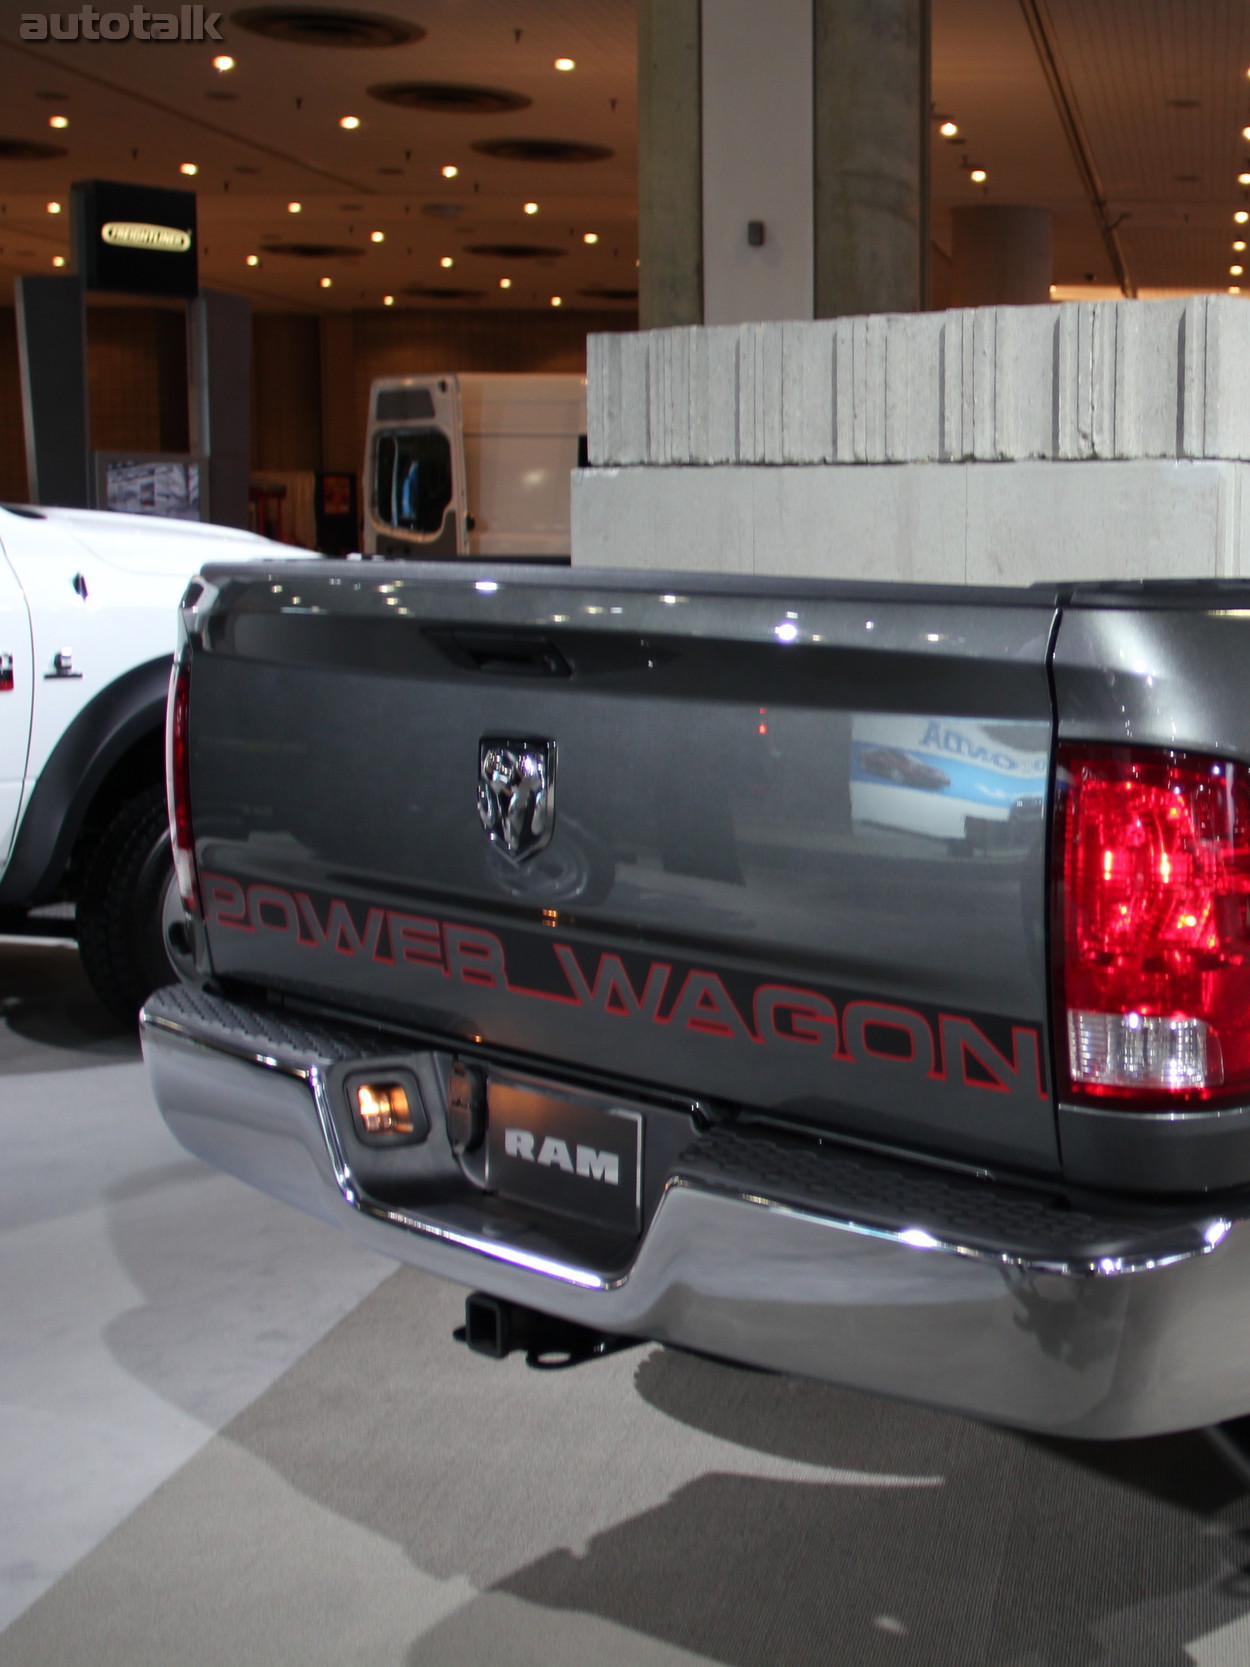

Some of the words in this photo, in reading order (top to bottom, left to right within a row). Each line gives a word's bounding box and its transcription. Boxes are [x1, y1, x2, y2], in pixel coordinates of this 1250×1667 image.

[202, 872, 509, 990] POWER
[553, 944, 1048, 1101] WAGON
[505, 1128, 619, 1186] RAM
